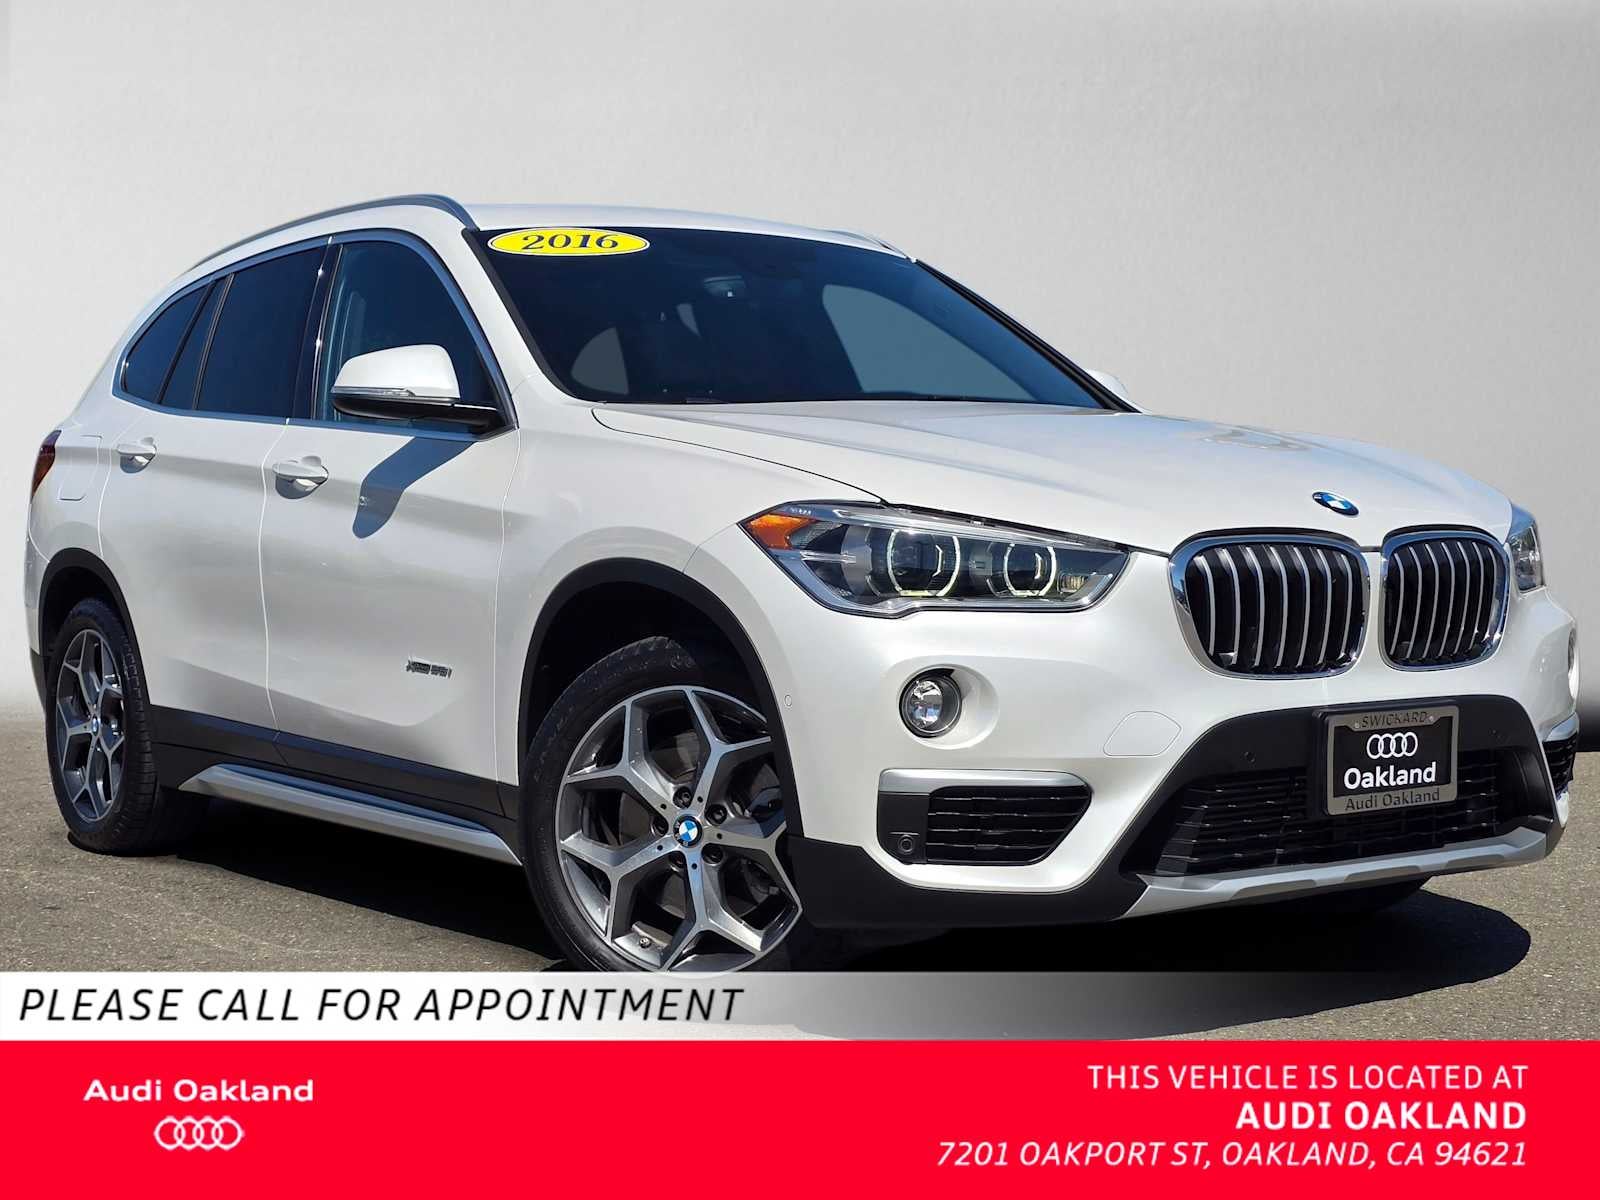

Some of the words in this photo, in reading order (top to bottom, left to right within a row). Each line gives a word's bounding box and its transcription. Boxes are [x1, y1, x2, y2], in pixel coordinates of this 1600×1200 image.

[521, 234, 618, 250] 2016
[1361, 711, 1428, 729] SWICKARD
[1343, 761, 1437, 790] Oakland
[1344, 795, 1379, 812] Audi
[1382, 787, 1440, 806] Oakland
